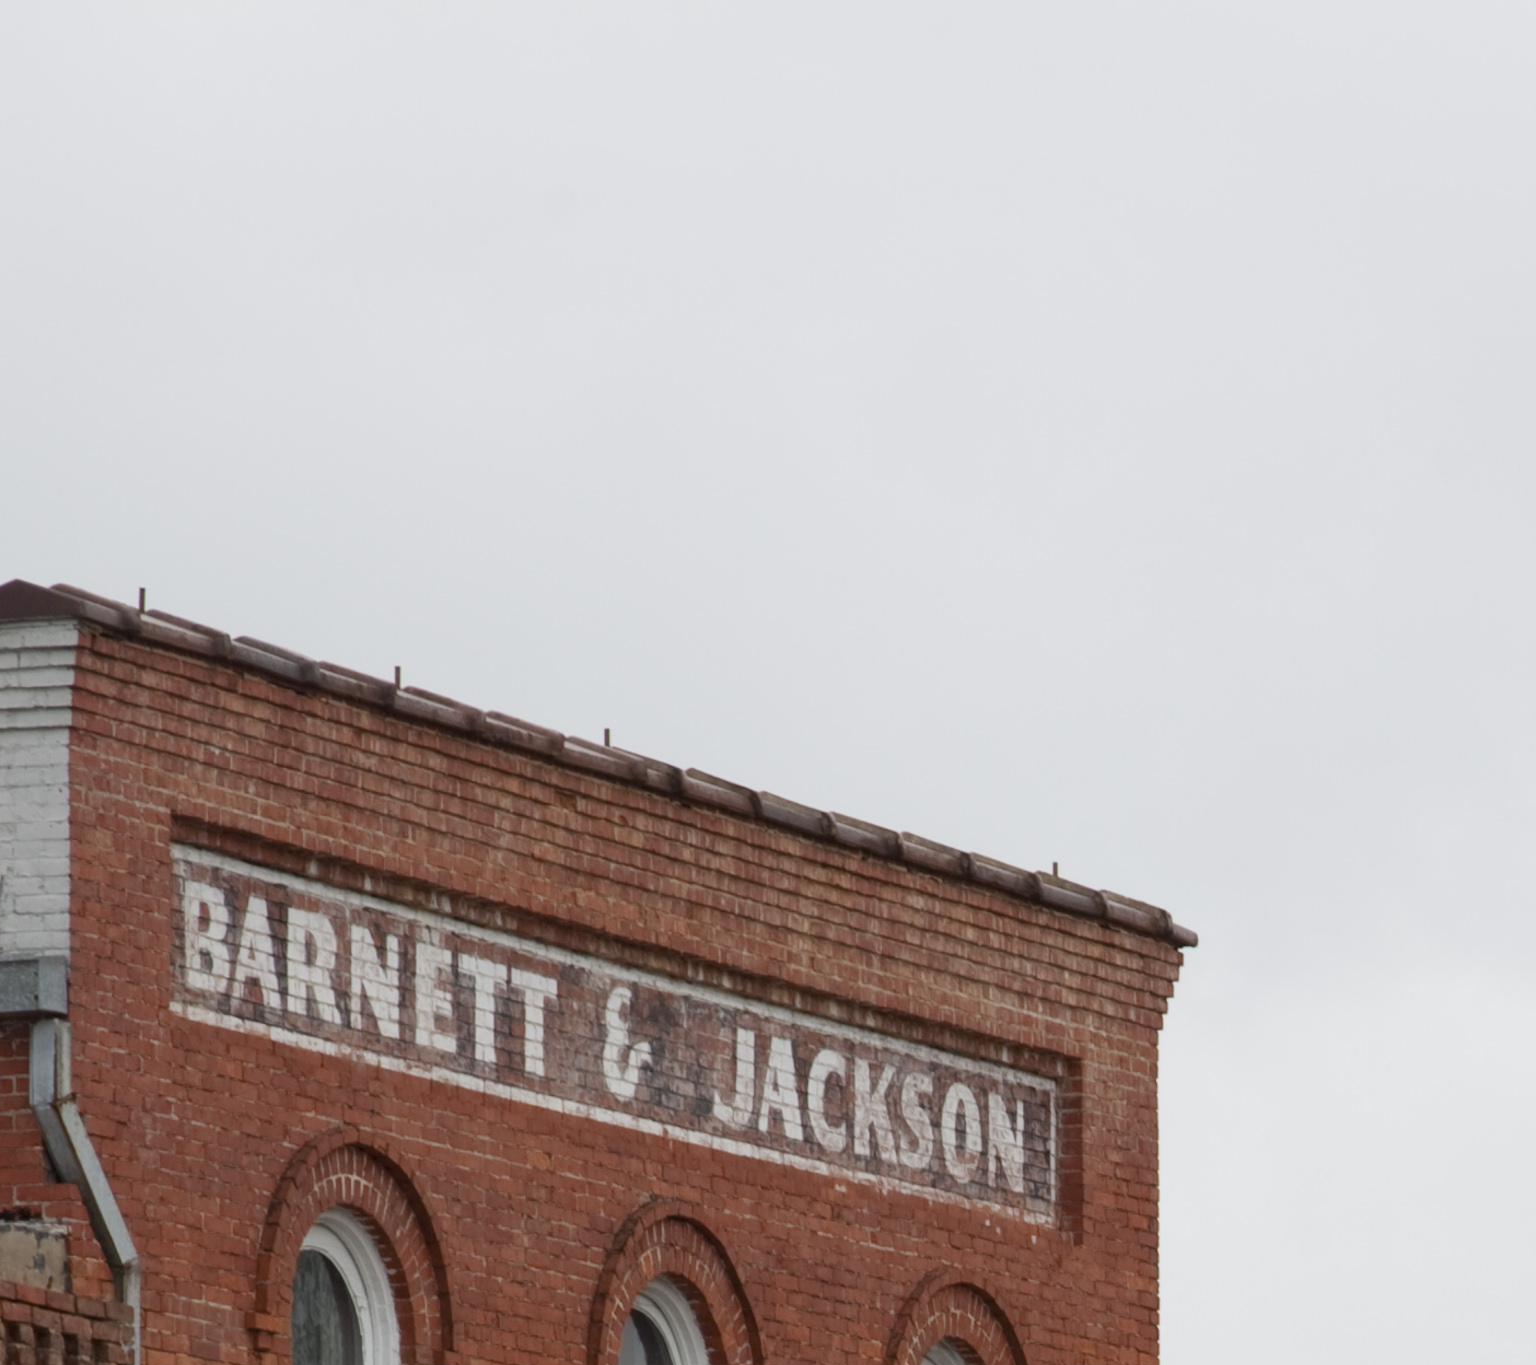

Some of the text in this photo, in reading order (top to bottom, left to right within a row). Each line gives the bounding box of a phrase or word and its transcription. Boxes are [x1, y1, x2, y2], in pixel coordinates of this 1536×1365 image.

[180, 879, 1026, 1194] BARNETT & JACKSON
